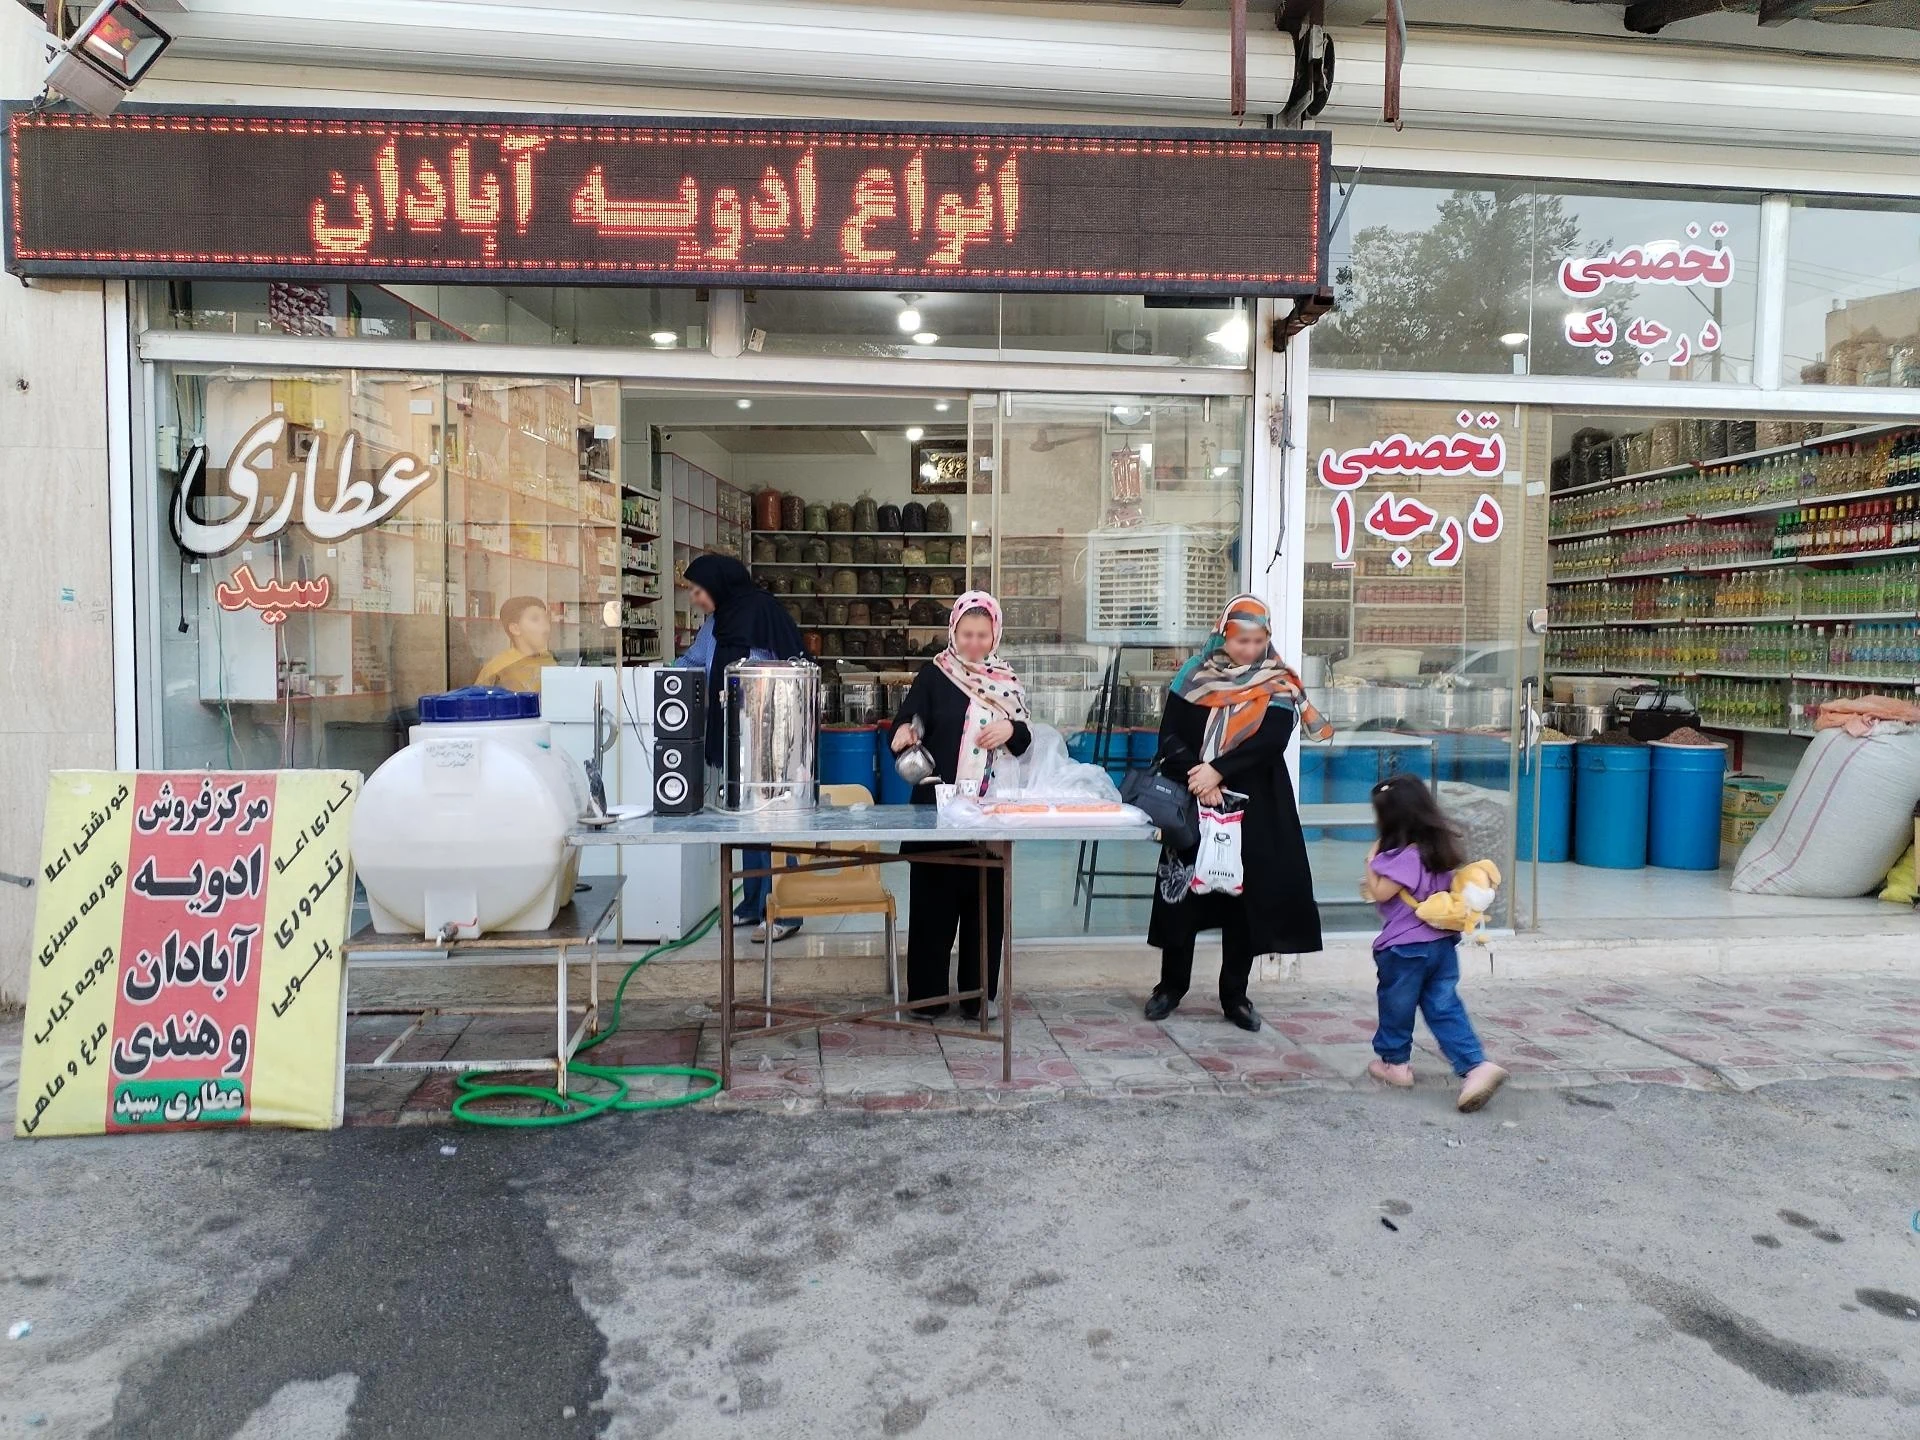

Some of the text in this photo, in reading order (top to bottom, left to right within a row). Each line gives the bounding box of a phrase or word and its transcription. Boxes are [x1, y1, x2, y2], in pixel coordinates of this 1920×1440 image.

[311, 132, 1019, 264] انواع ادویه آبادان
[1560, 222, 1733, 296] تخصصی
[1567, 309, 1720, 364] درجه یک
[171, 414, 435, 556] عطاری
[1320, 411, 1503, 488] تخصصی
[1366, 493, 1502, 566] درجه
[215, 564, 330, 624] سید
[38, 861, 122, 967] قورمه سبزی
[133, 845, 262, 915] ادویه
[274, 850, 344, 950] تندوری
[34, 946, 113, 1044] جوجه کباب
[125, 924, 259, 1003] آبادان
[80, 1022, 107, 1066] مرغ
[113, 1012, 248, 1077] و هندی
[23, 1074, 65, 1133] ماهی
[114, 1081, 244, 1121] عطاری سید
